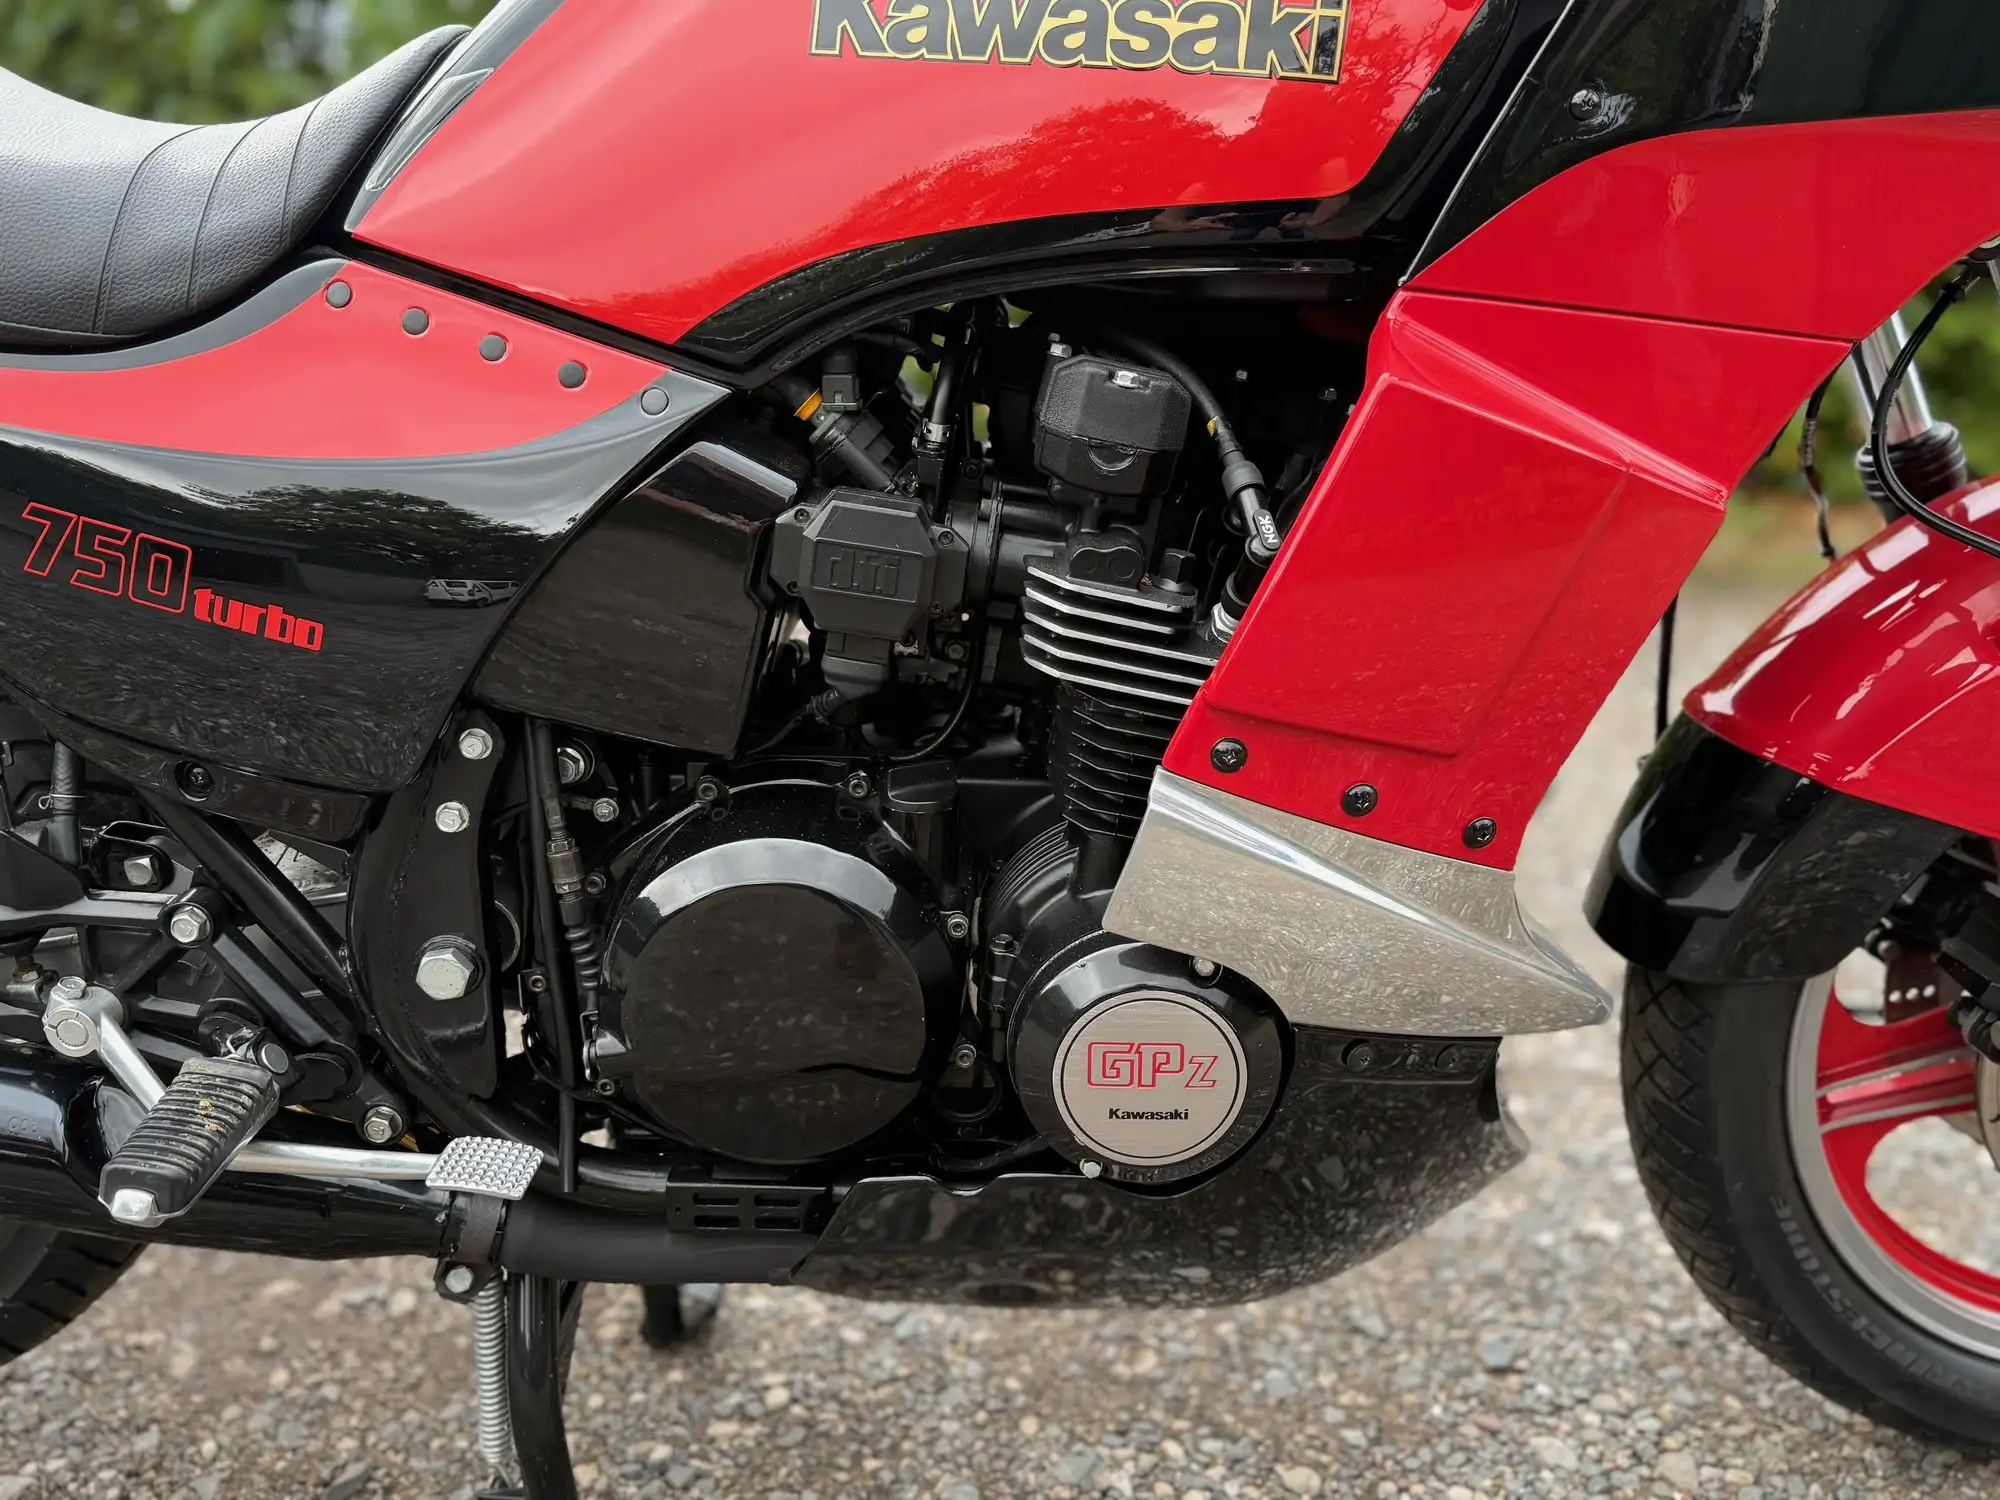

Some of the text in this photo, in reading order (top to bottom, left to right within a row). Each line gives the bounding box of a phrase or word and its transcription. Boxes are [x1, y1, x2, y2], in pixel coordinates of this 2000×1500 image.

[808, 0, 1346, 84] Kawasaki
[1258, 515, 1278, 543] NGK
[22, 502, 323, 651] 750 turbo
[1108, 1108, 1189, 1120] Kawasaki
